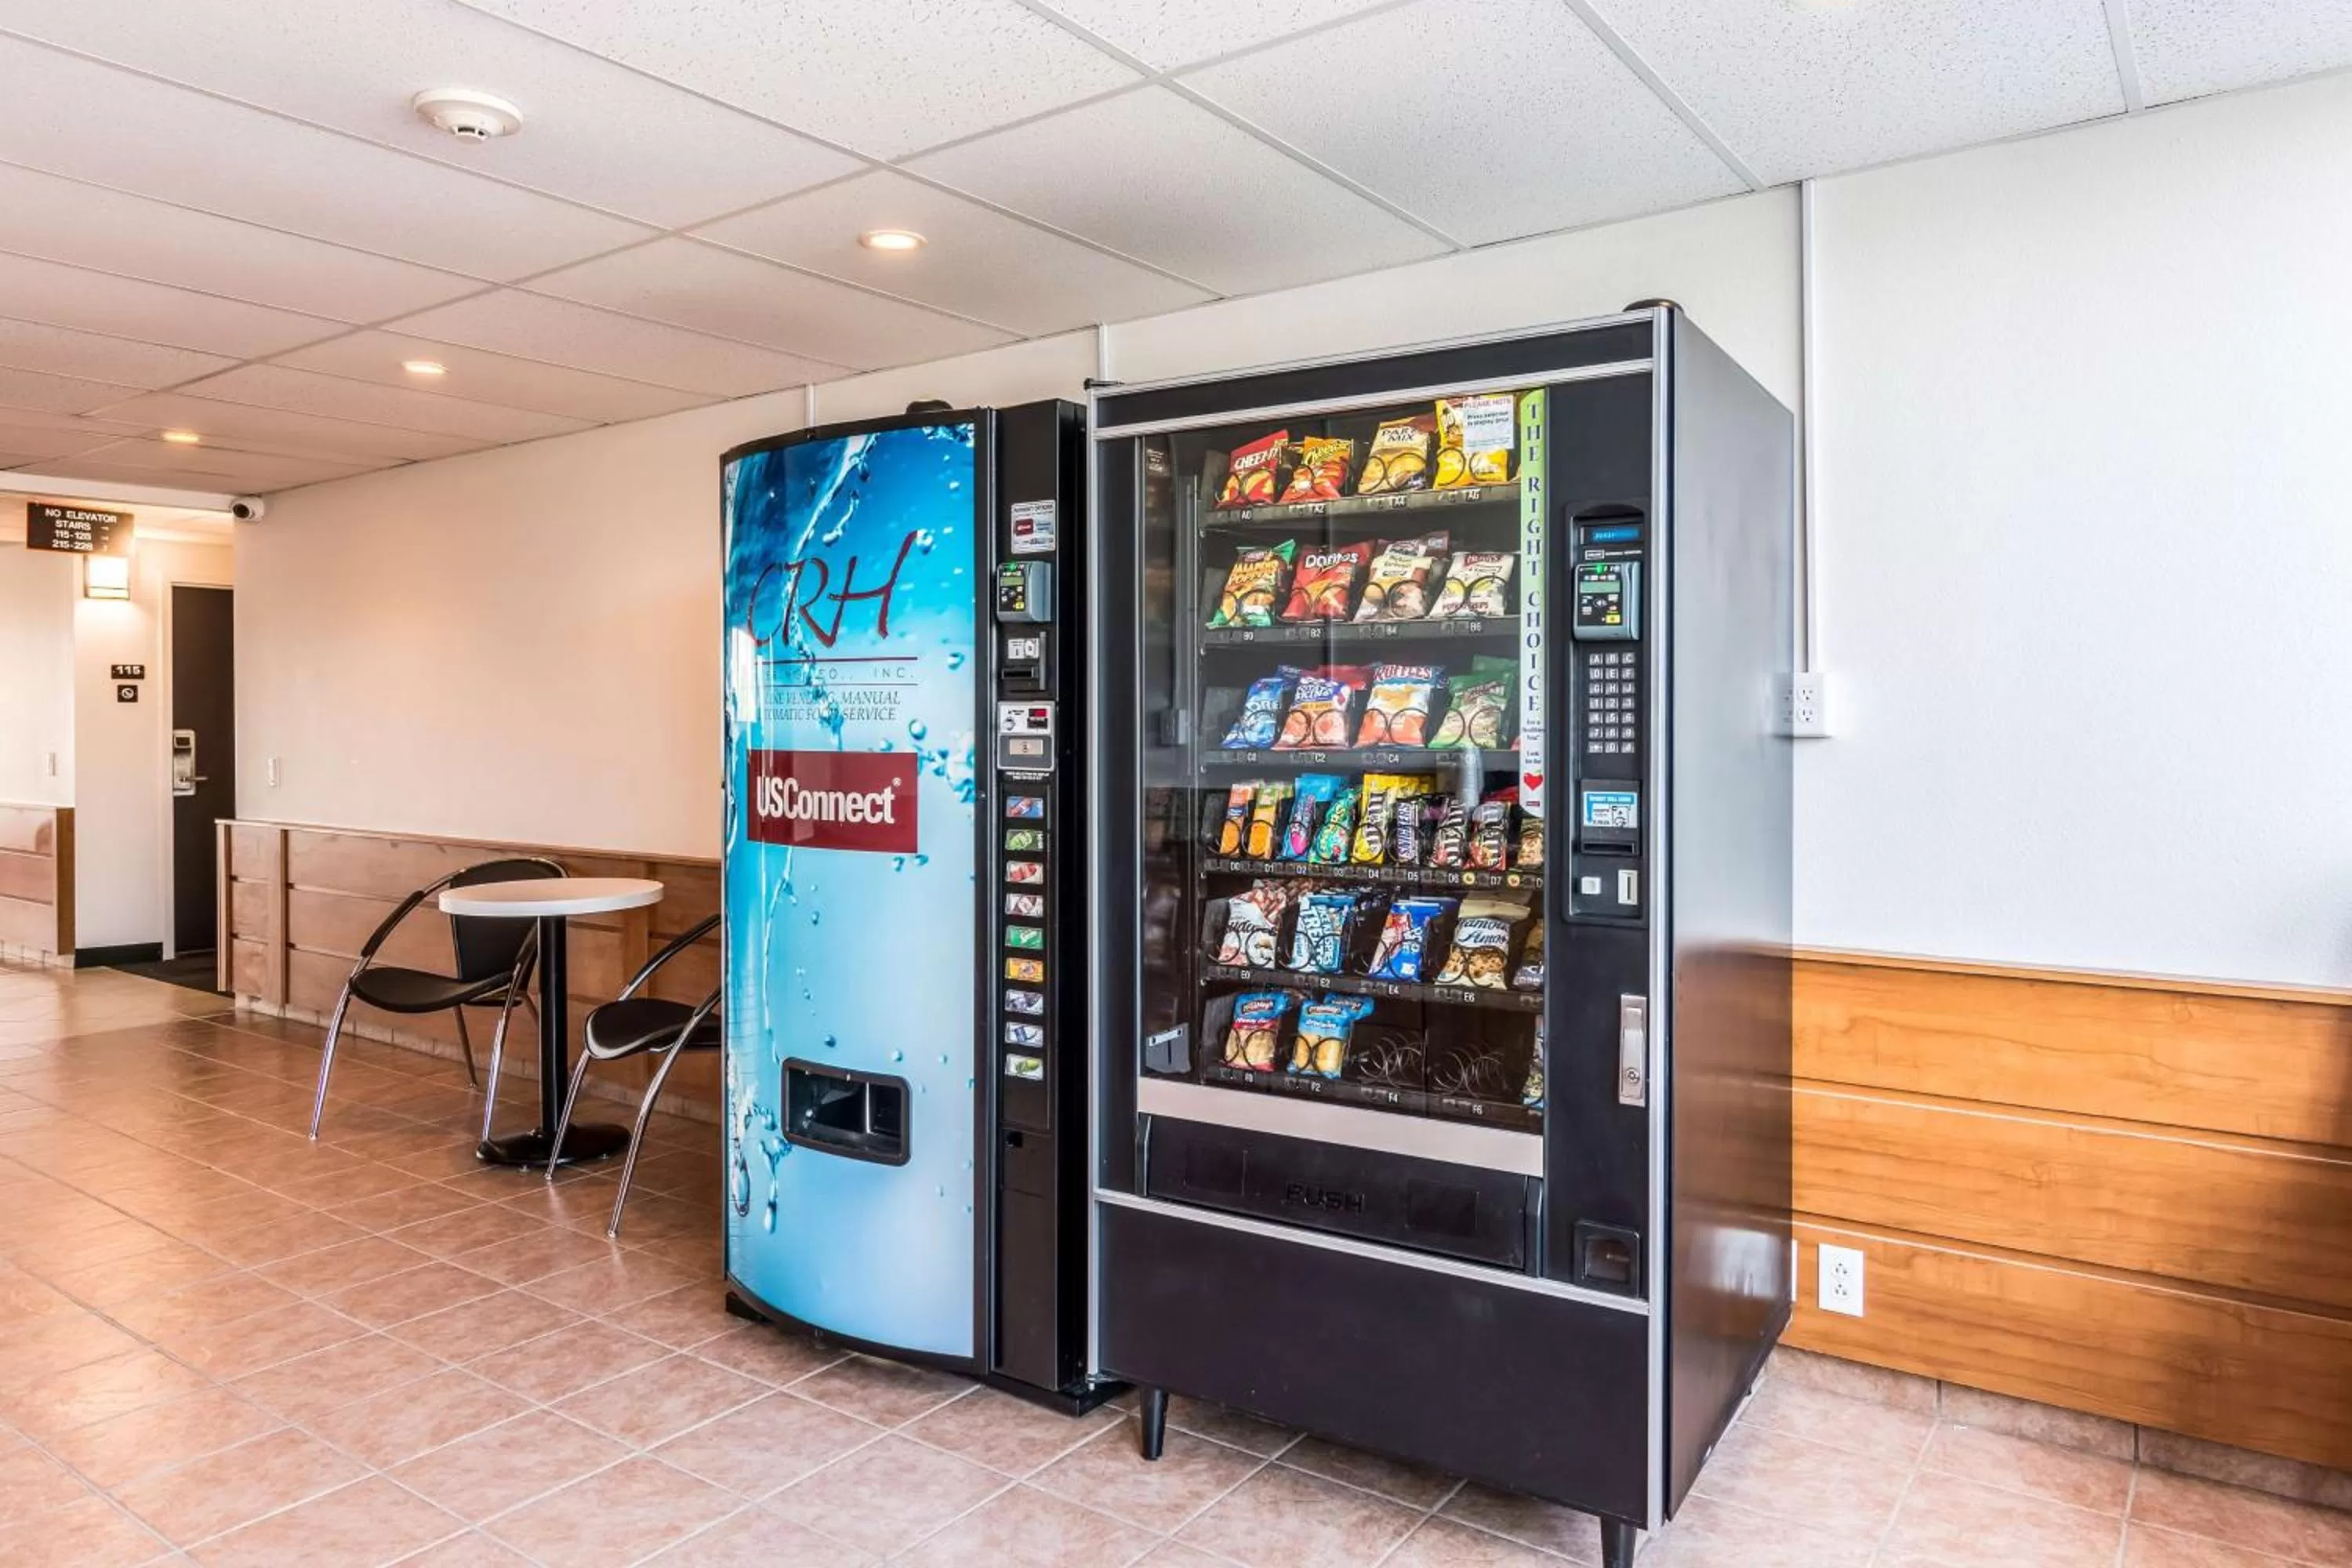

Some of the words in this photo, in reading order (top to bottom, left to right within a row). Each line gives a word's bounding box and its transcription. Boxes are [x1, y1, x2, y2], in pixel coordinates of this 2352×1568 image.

[1526, 404, 1541, 462] THE
[45, 508, 62, 517] NO
[66, 510, 117, 524] ELEVATOR
[55, 520, 91, 531] STAIRS
[1526, 477, 1541, 576] RIGHT
[1305, 552, 1359, 568] Doritos
[1526, 590, 1541, 712] CHOICE
[115, 666, 140, 675] 115
[841, 690, 901, 705] MANUAL
[843, 706, 896, 720] SERVICE
[757, 775, 895, 824] USConnect
[1458, 931, 1507, 944] Amos
[1286, 1178, 1365, 1217] PUSH
